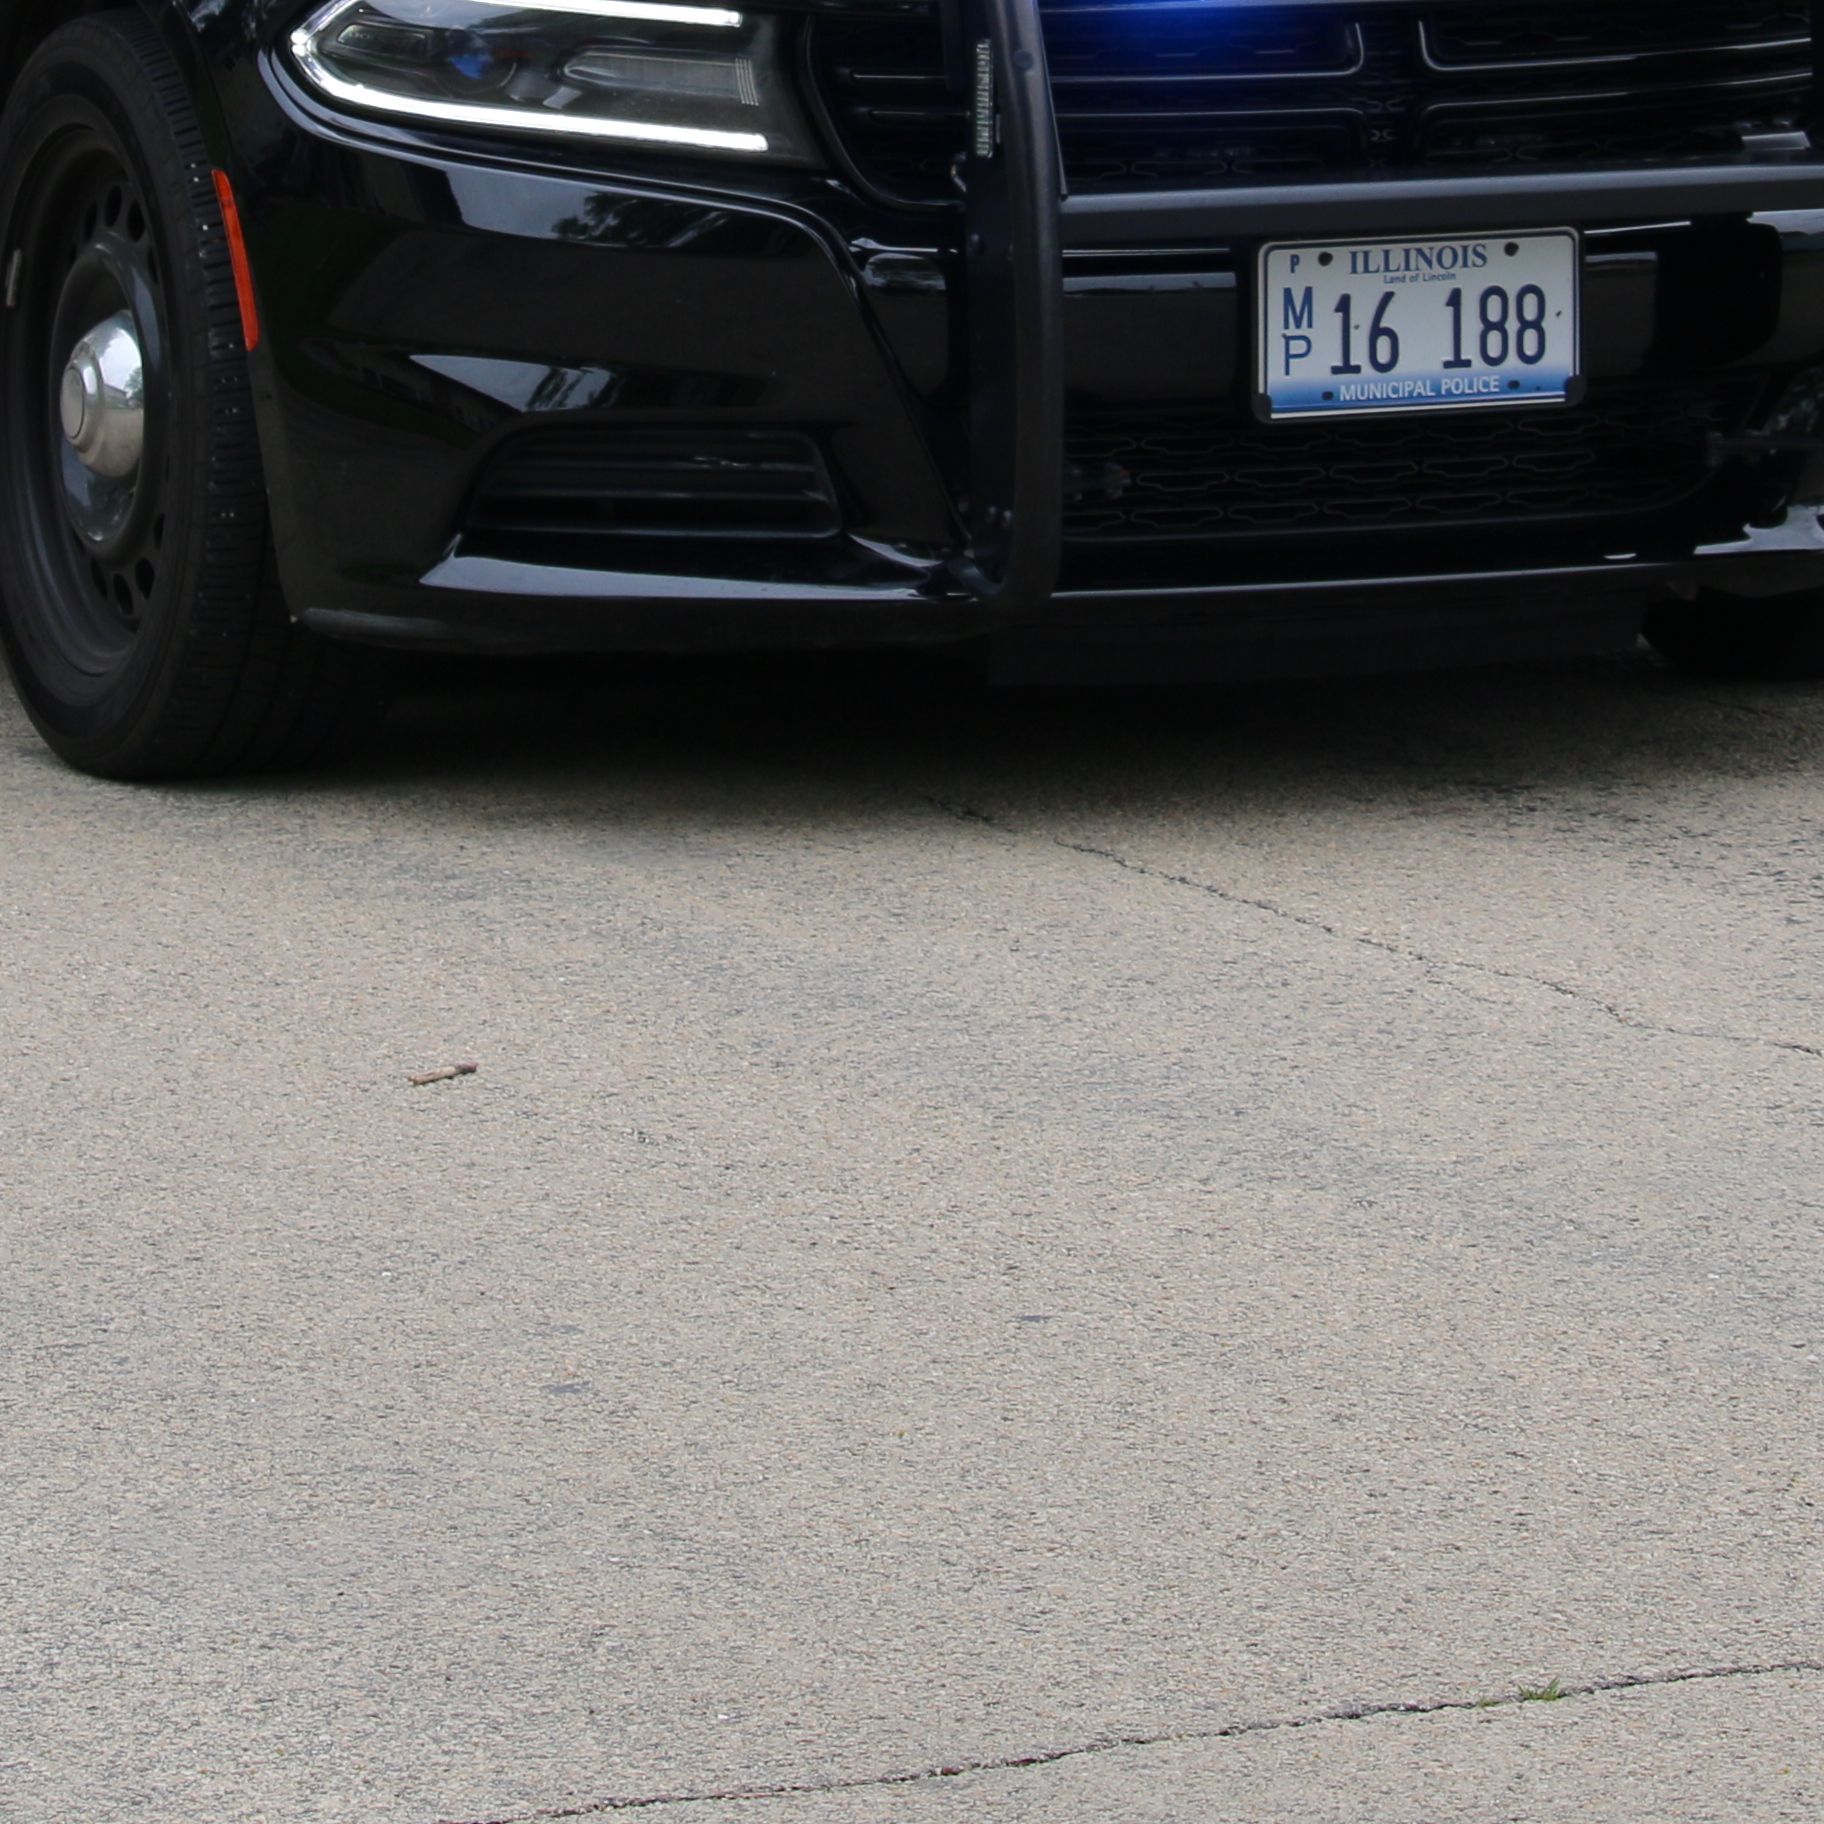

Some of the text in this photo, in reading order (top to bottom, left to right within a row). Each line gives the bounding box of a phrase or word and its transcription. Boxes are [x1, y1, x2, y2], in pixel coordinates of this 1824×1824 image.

[1349, 243, 1488, 274] ILLINOIS
[1384, 274, 1406, 284] Land
[1409, 273, 1419, 283] of
[1330, 284, 1546, 375] 16 188
[1340, 376, 1500, 401] MUNICIPAL POLICE
